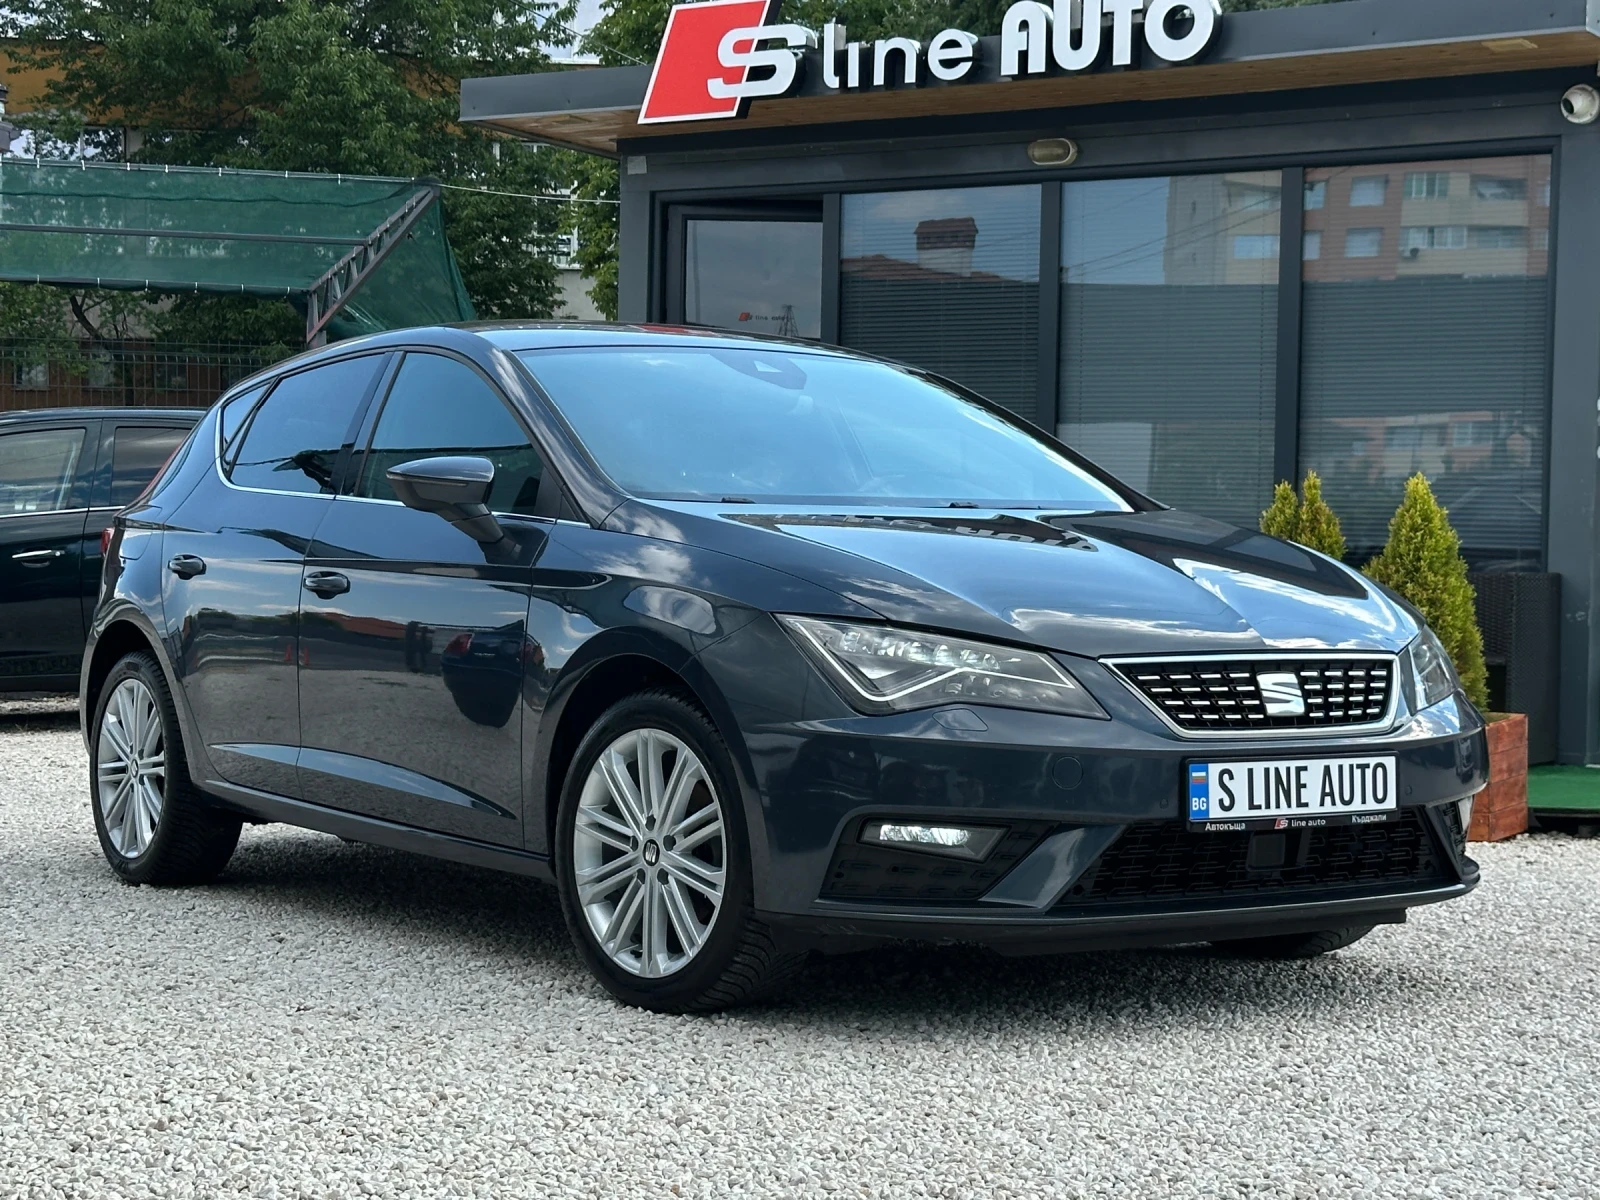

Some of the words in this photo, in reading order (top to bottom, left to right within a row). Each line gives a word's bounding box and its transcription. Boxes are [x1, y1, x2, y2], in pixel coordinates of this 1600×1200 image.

[708, 25, 797, 99] S
[823, 23, 975, 90] line
[1000, 0, 1218, 76] AUTO
[1217, 768, 1236, 812] S
[1247, 765, 1309, 811] LINE
[1319, 761, 1388, 807] AUTO
[1192, 797, 1207, 811] BG
[1291, 819, 1307, 827] line
[1307, 819, 1326, 827] auto
[1351, 814, 1387, 823] Кърджали
[1205, 822, 1246, 831] Автокъща
